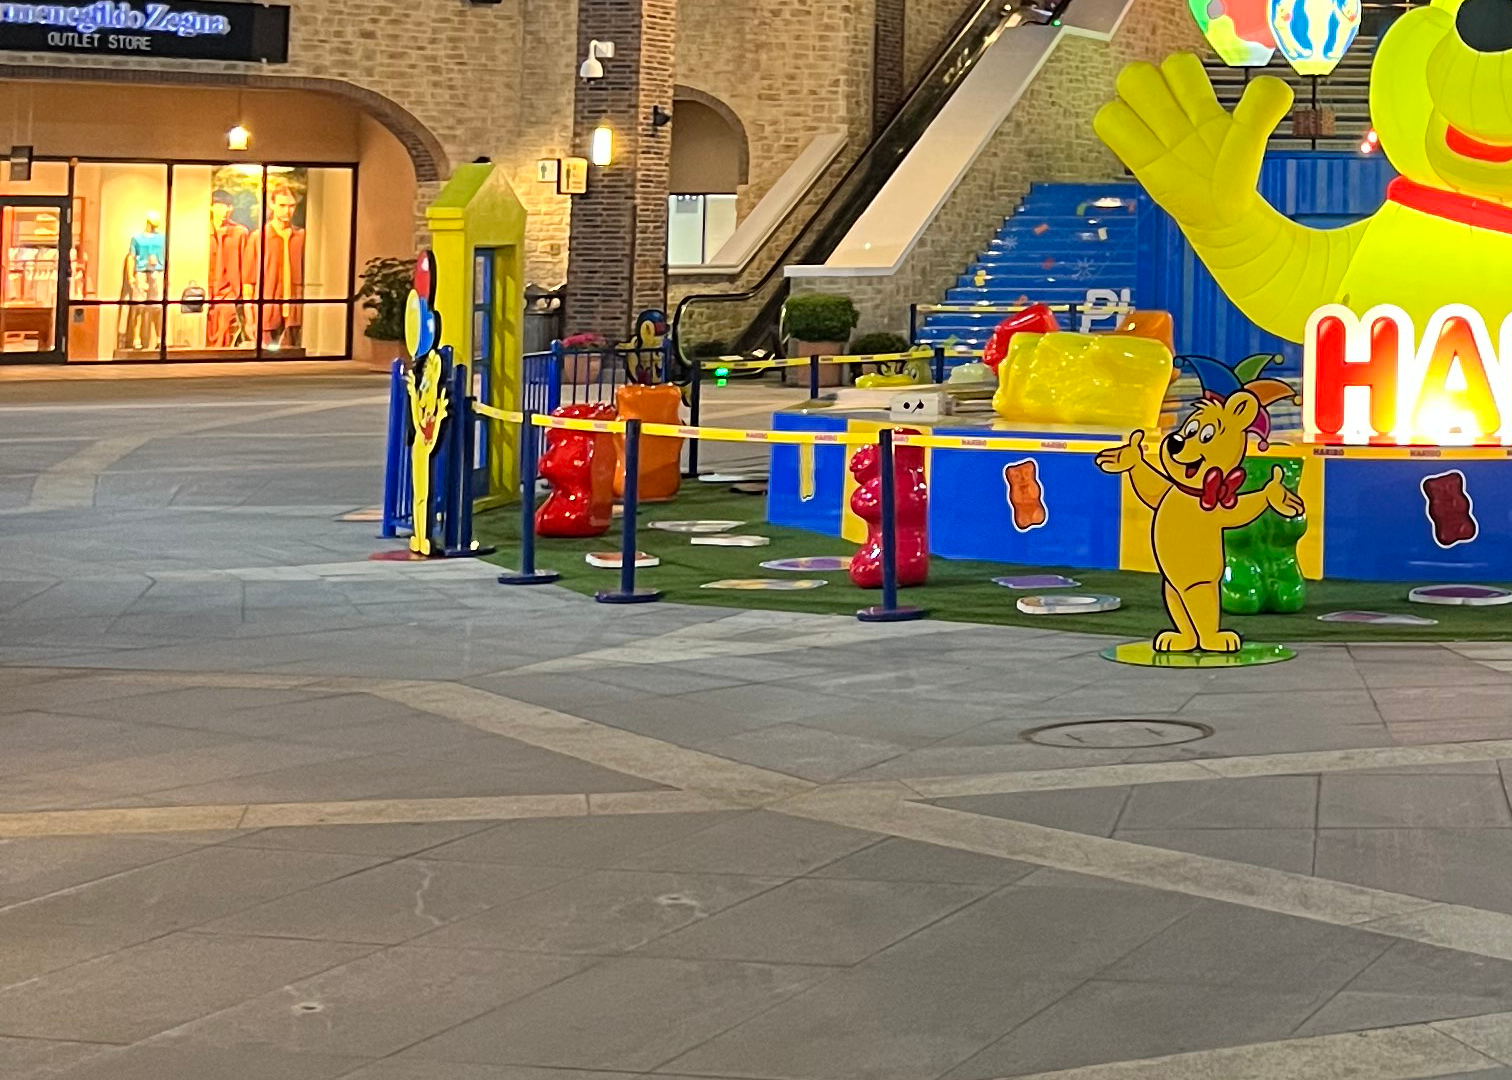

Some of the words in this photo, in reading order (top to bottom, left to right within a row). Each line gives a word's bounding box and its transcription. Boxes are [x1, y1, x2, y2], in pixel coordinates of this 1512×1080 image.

[145, 3, 231, 37] Zegna
[48, 31, 101, 48] OUTLET
[108, 35, 152, 51] STORE
